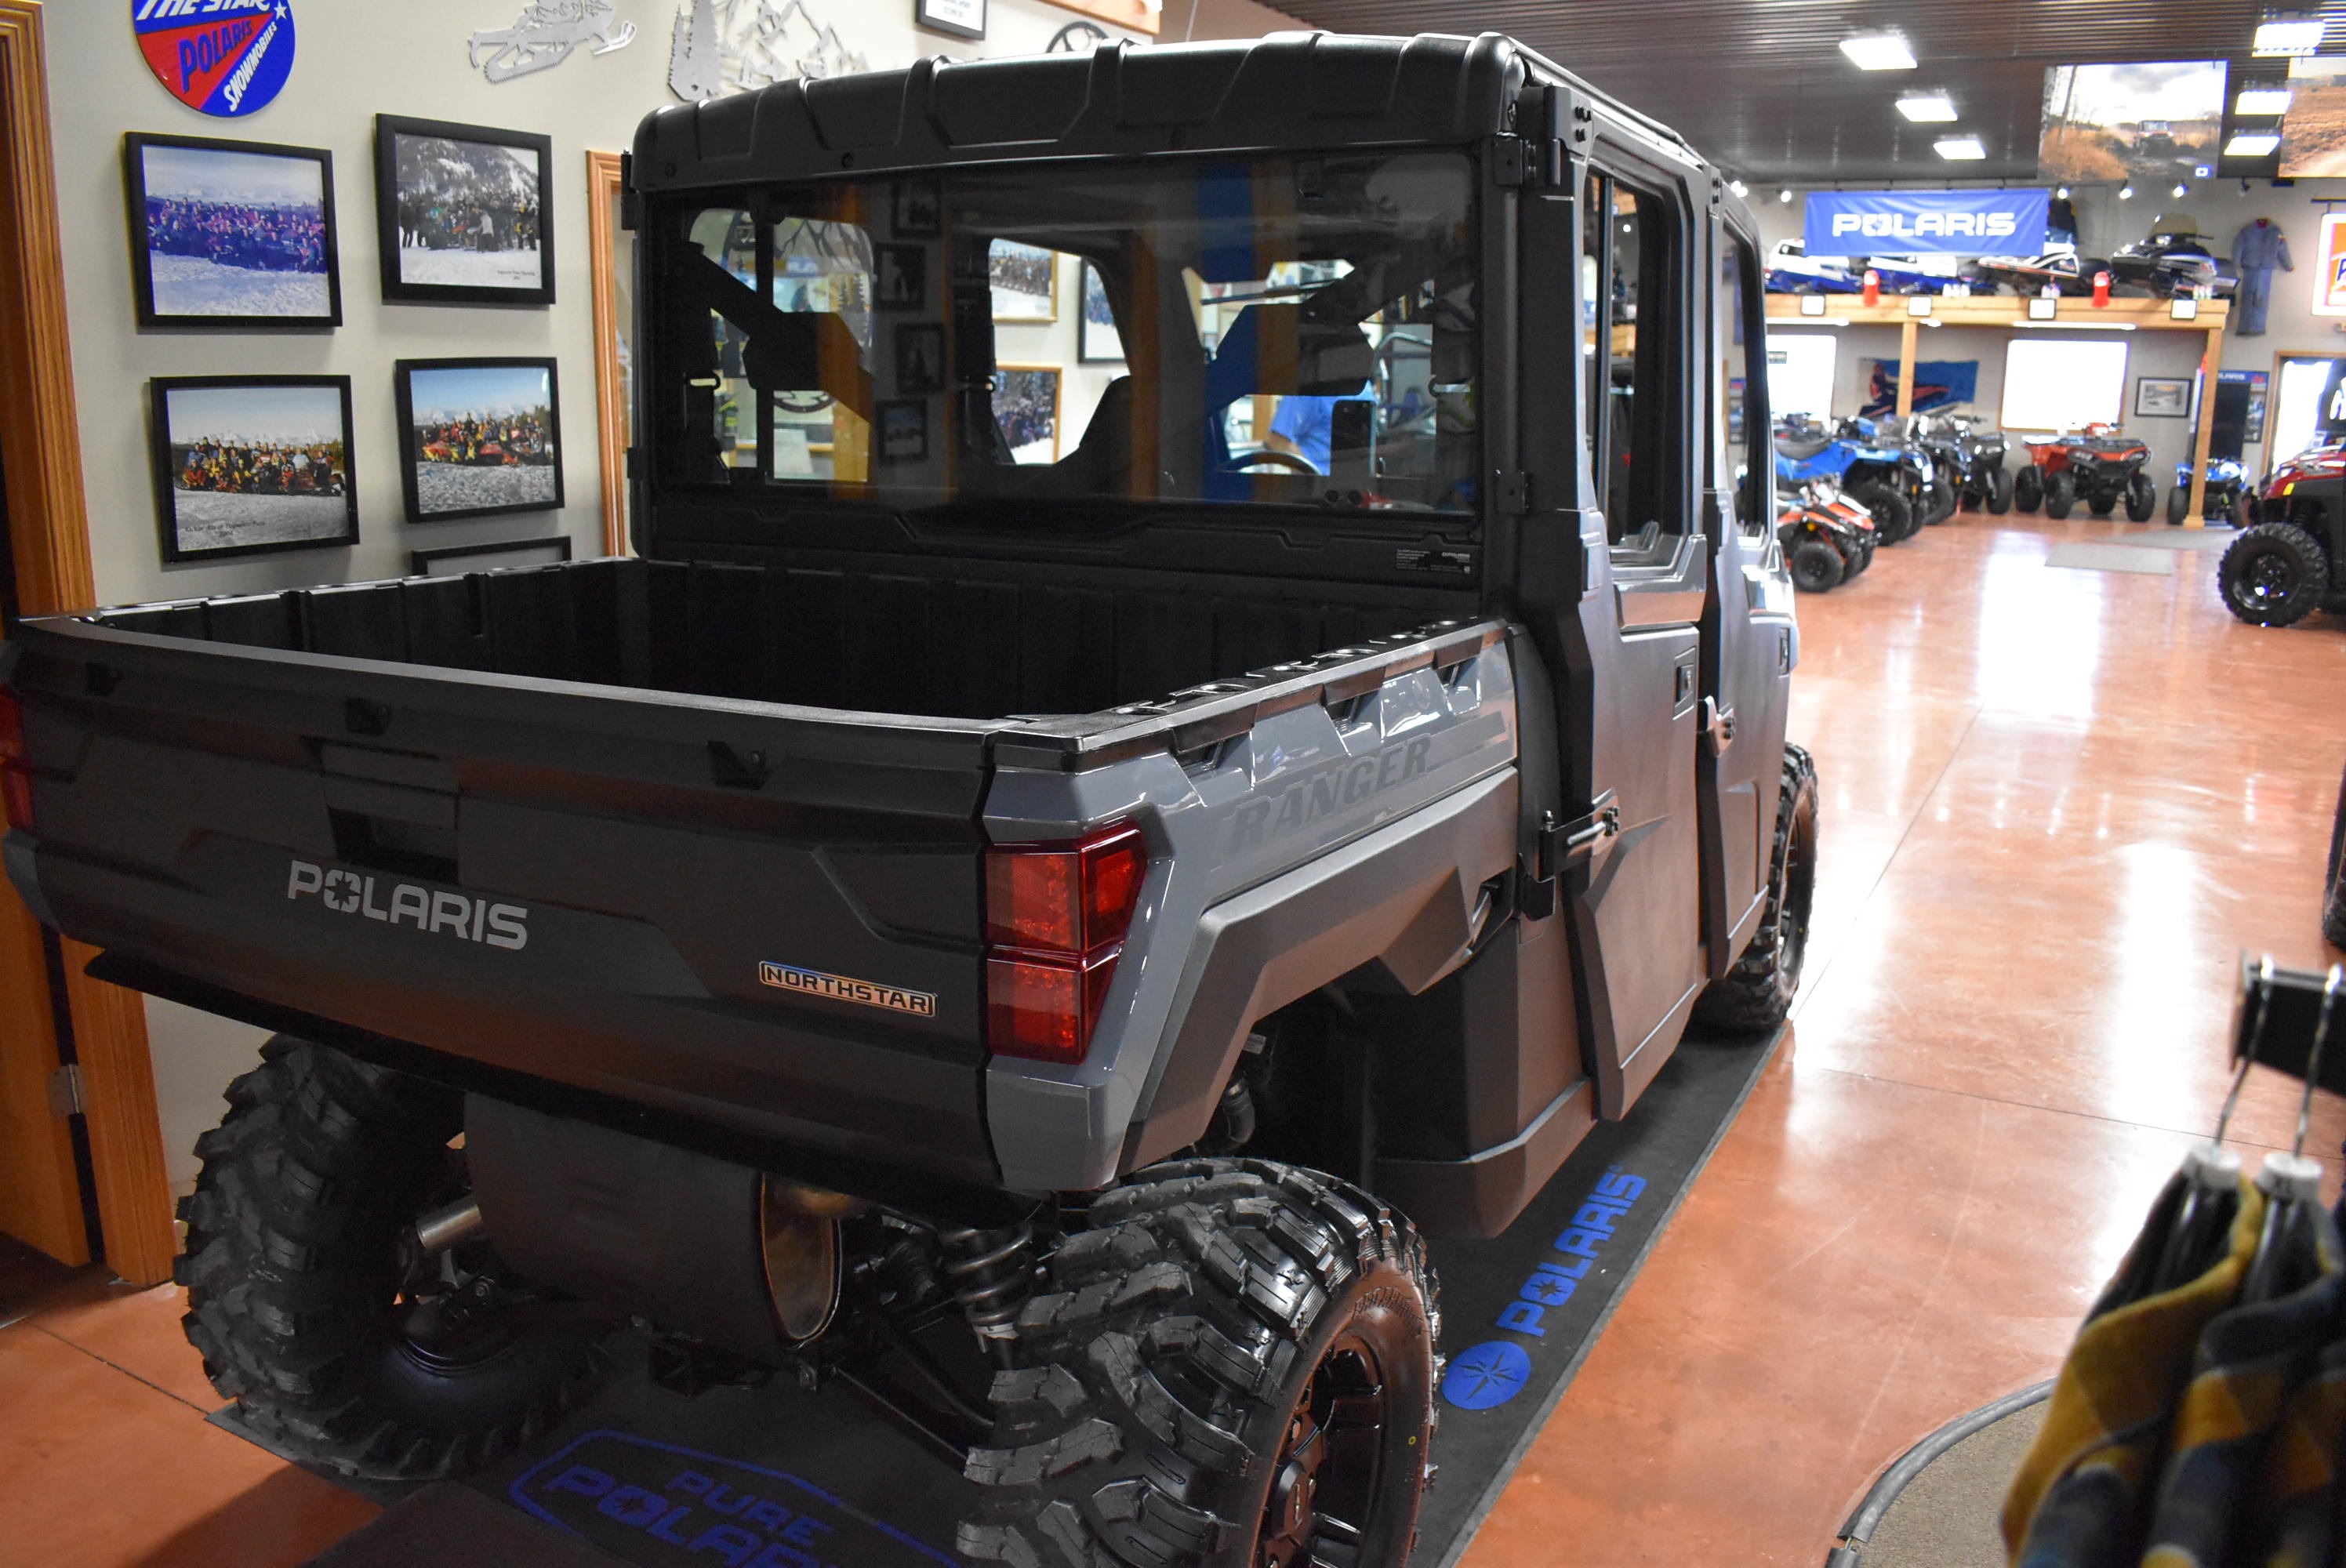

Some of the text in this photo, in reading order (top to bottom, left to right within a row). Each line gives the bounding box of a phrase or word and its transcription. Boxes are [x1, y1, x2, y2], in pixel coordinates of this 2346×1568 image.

[177, 19, 252, 93] POLARIS
[223, 21, 278, 112] SNOWMOBILES
[1832, 212, 2017, 236] POLARIS
[1228, 732, 1432, 853] RANGER
[287, 859, 528, 950] POLARIS
[767, 966, 928, 1012] NORTHSTAR
[1494, 1171, 1647, 1338] POLARIS
[543, 1464, 840, 1568] POLAR
[666, 1468, 833, 1548] PURE
